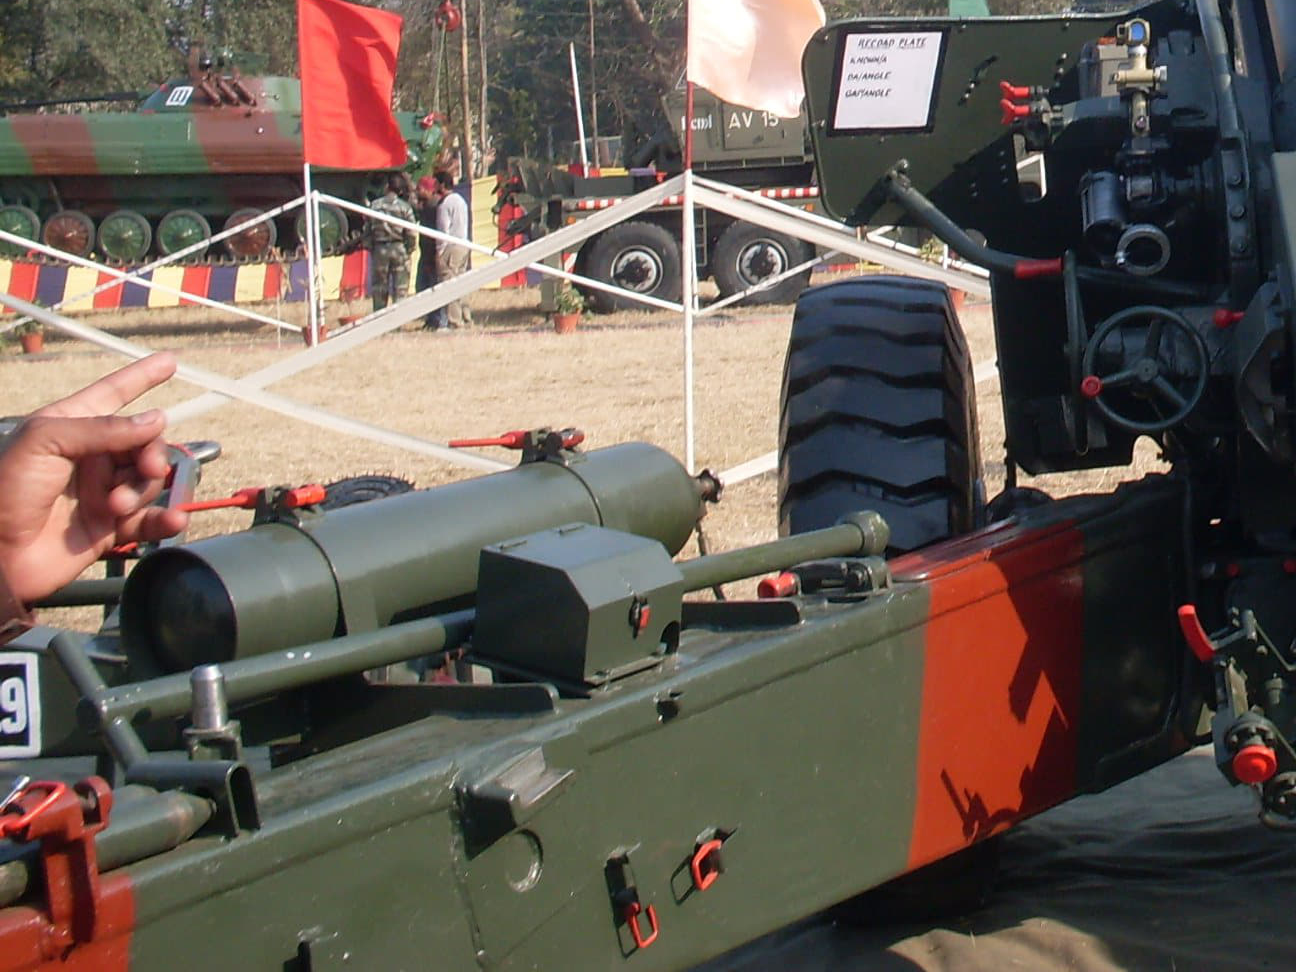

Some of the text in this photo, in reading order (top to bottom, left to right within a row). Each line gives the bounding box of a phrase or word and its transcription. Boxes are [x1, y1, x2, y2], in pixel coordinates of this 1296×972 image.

[858, 37, 927, 48] RECORD PLATE
[729, 111, 753, 129] AV
[761, 110, 780, 128] 15
